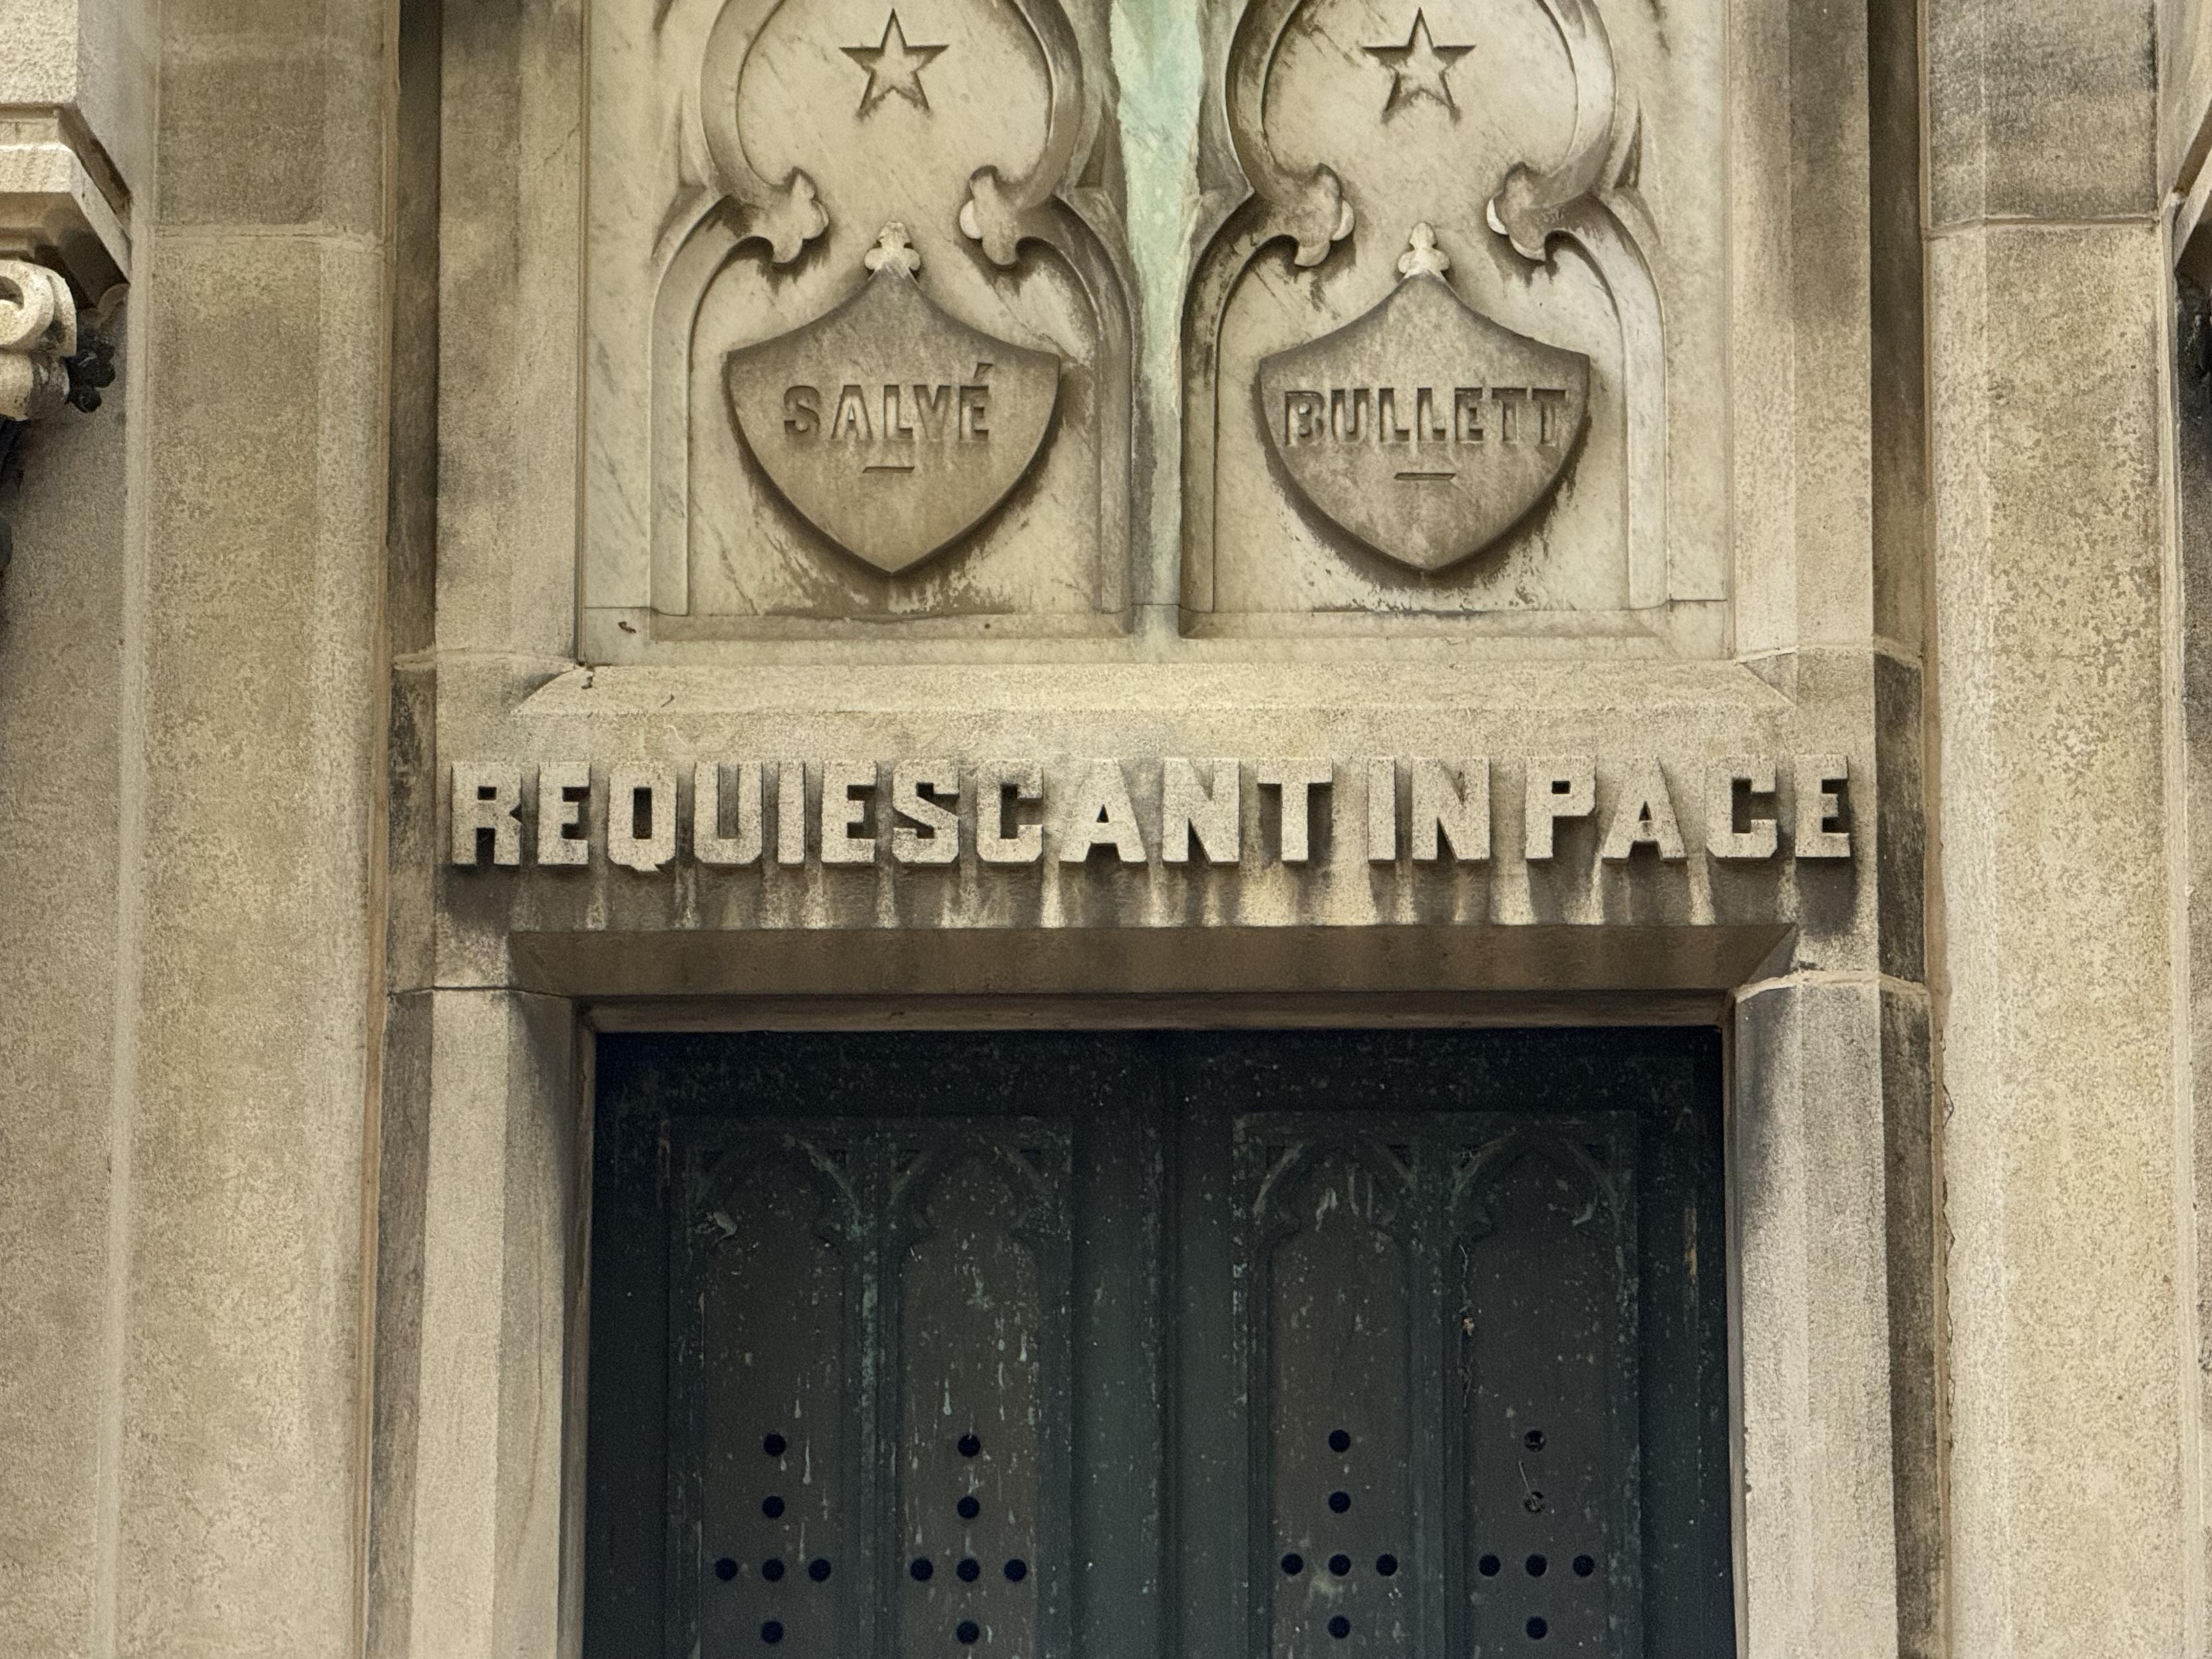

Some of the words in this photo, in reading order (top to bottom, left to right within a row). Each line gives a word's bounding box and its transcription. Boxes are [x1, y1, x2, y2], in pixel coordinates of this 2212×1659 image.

[1285, 387, 1567, 447] BULLETT
[450, 758, 1333, 872] REQUIESCANT
[1368, 756, 1490, 862] IN
[1525, 754, 1851, 860] PACE
